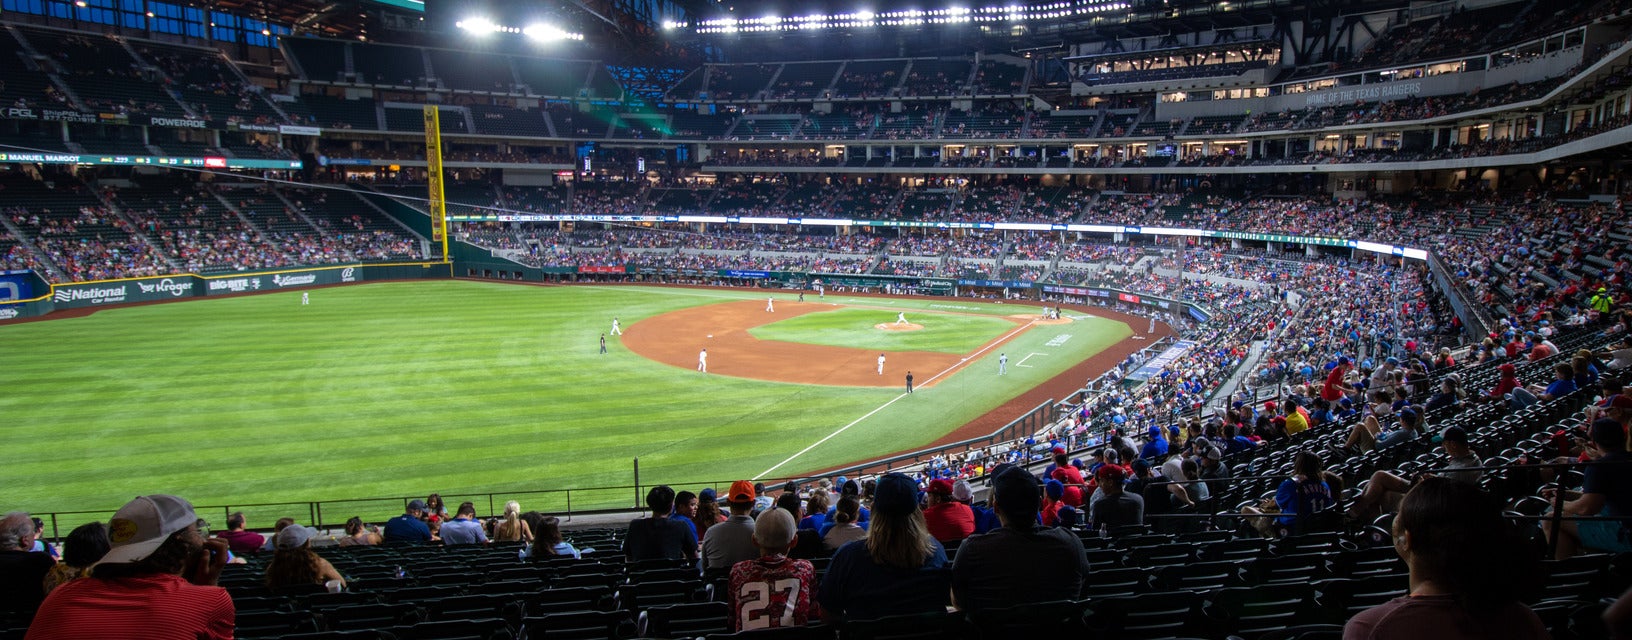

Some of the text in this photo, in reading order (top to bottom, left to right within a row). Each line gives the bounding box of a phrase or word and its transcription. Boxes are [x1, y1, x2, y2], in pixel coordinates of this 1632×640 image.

[1306, 82, 1421, 105] HOME OF THE TEXAS RANGERS
[9, 108, 37, 118] PGL
[151, 117, 206, 128] POWERADE
[9, 154, 45, 162] MANUEL
[156, 278, 193, 297] Kroger
[210, 280, 228, 290] BIG
[228, 278, 249, 288] BITE
[72, 285, 126, 300] National
[741, 578, 800, 631] 27
